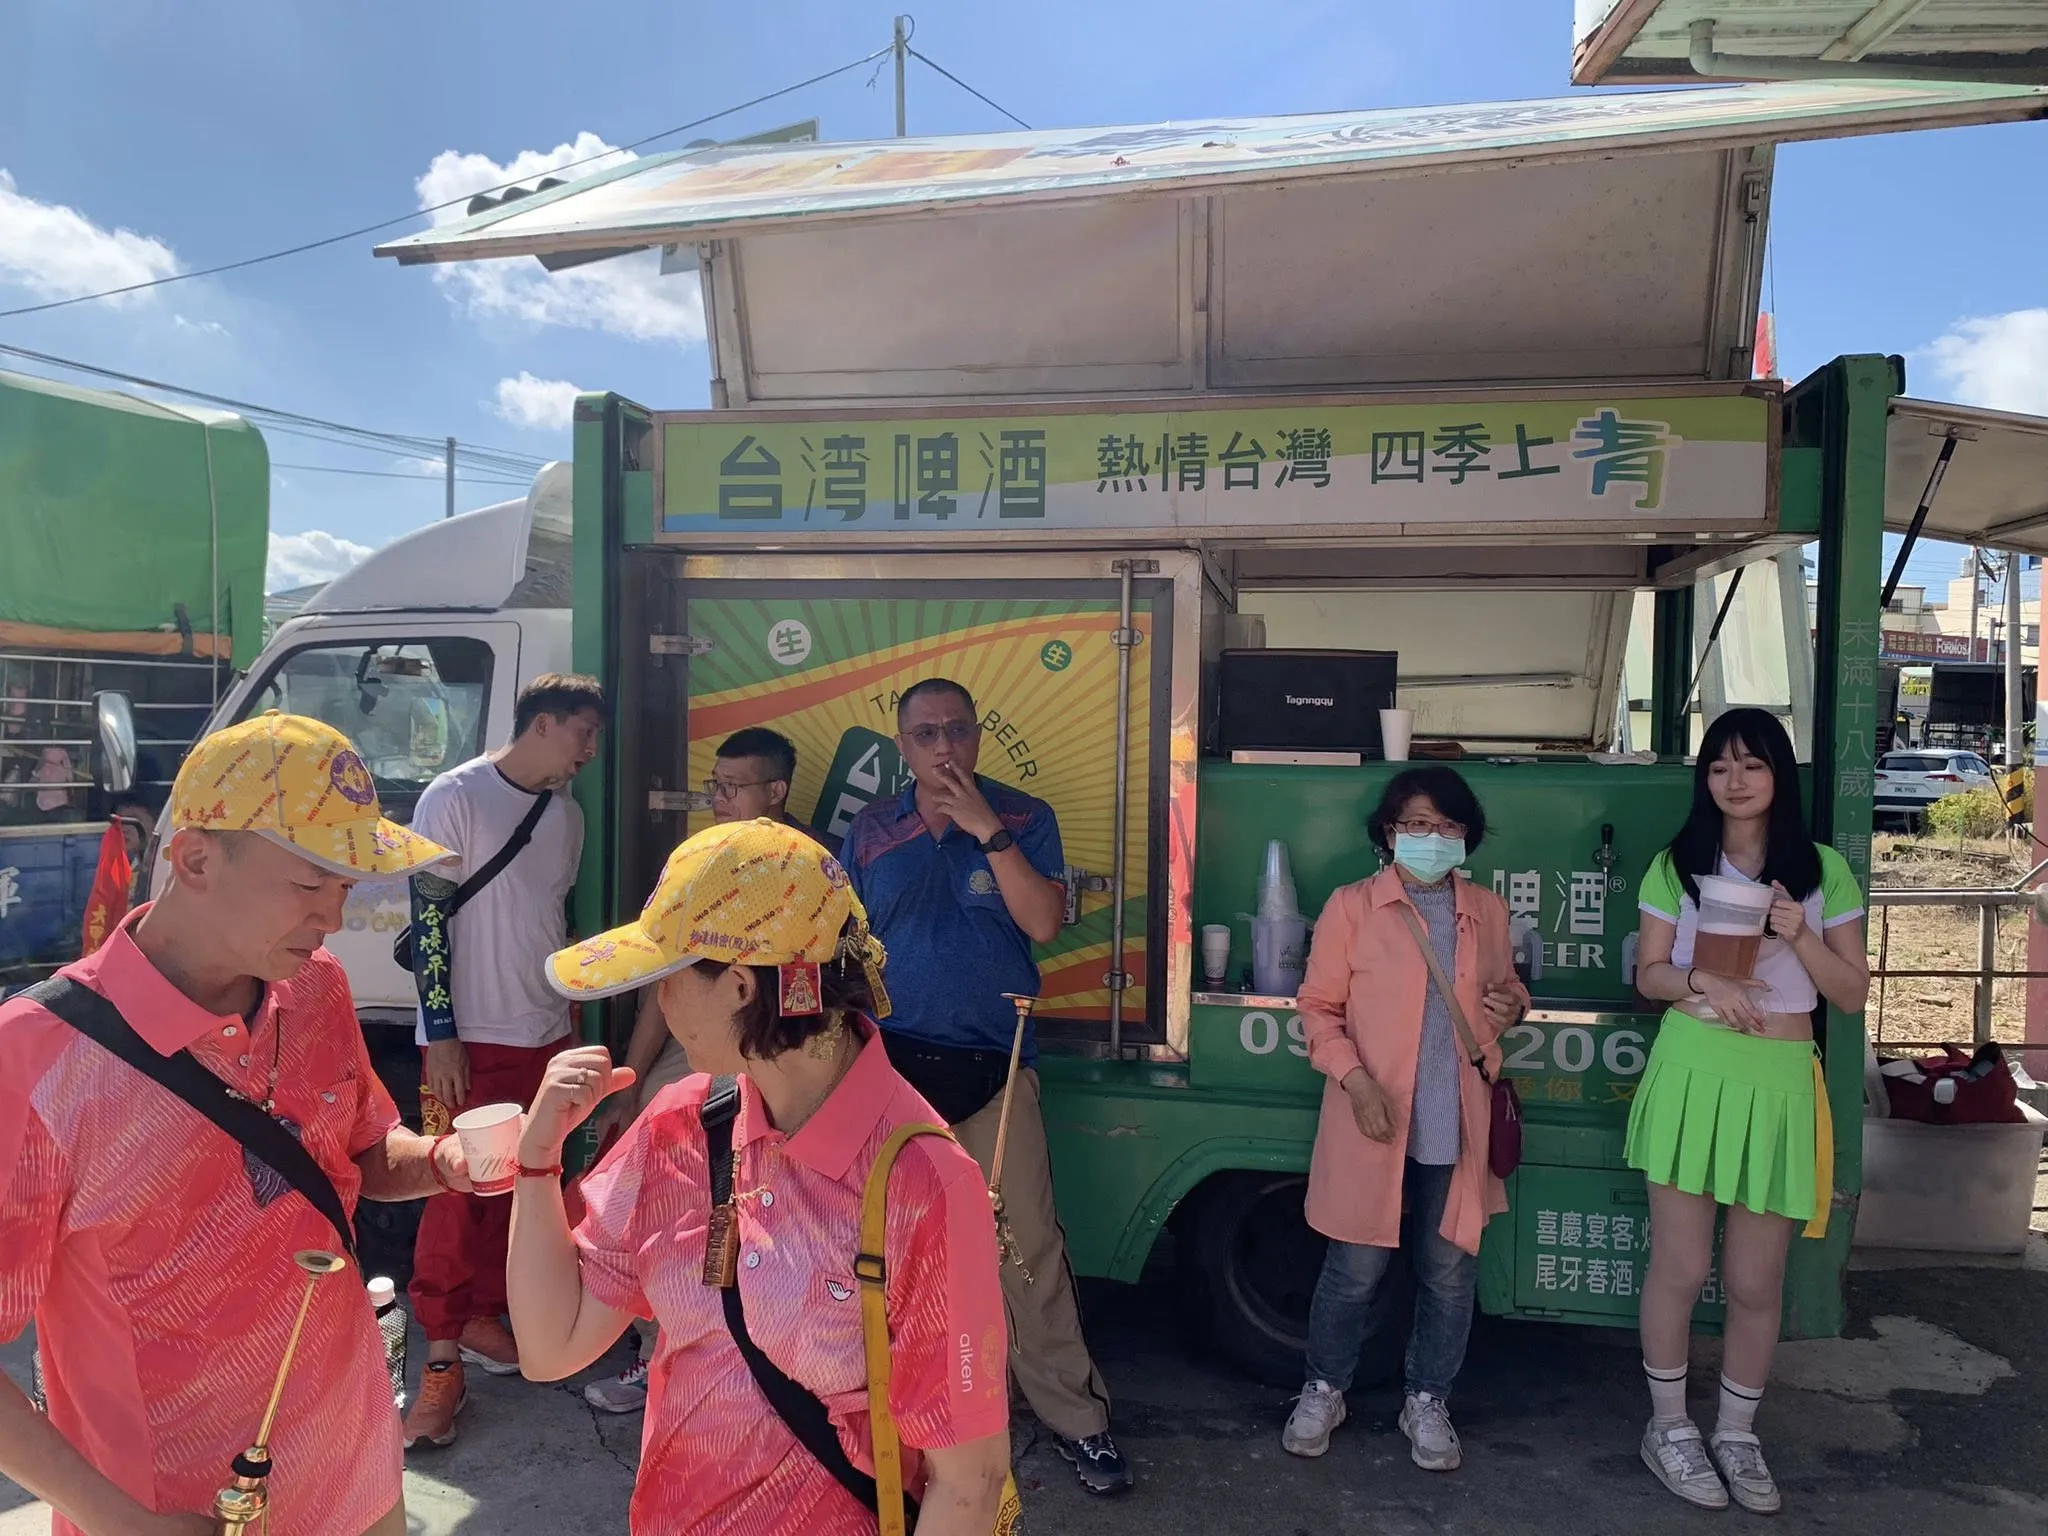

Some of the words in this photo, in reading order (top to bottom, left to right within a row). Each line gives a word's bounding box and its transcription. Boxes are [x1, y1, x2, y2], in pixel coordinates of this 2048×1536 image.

[1096, 428, 1332, 493] 熱情台灣
[1370, 408, 1682, 511] 四季上青
[775, 624, 805, 657] 生
[1043, 644, 1069, 670] 生
[981, 710, 1038, 781] BEER
[1455, 867, 1604, 936] 啤酒
[1541, 942, 1607, 969] EER
[960, 1333, 974, 1393] aiken
